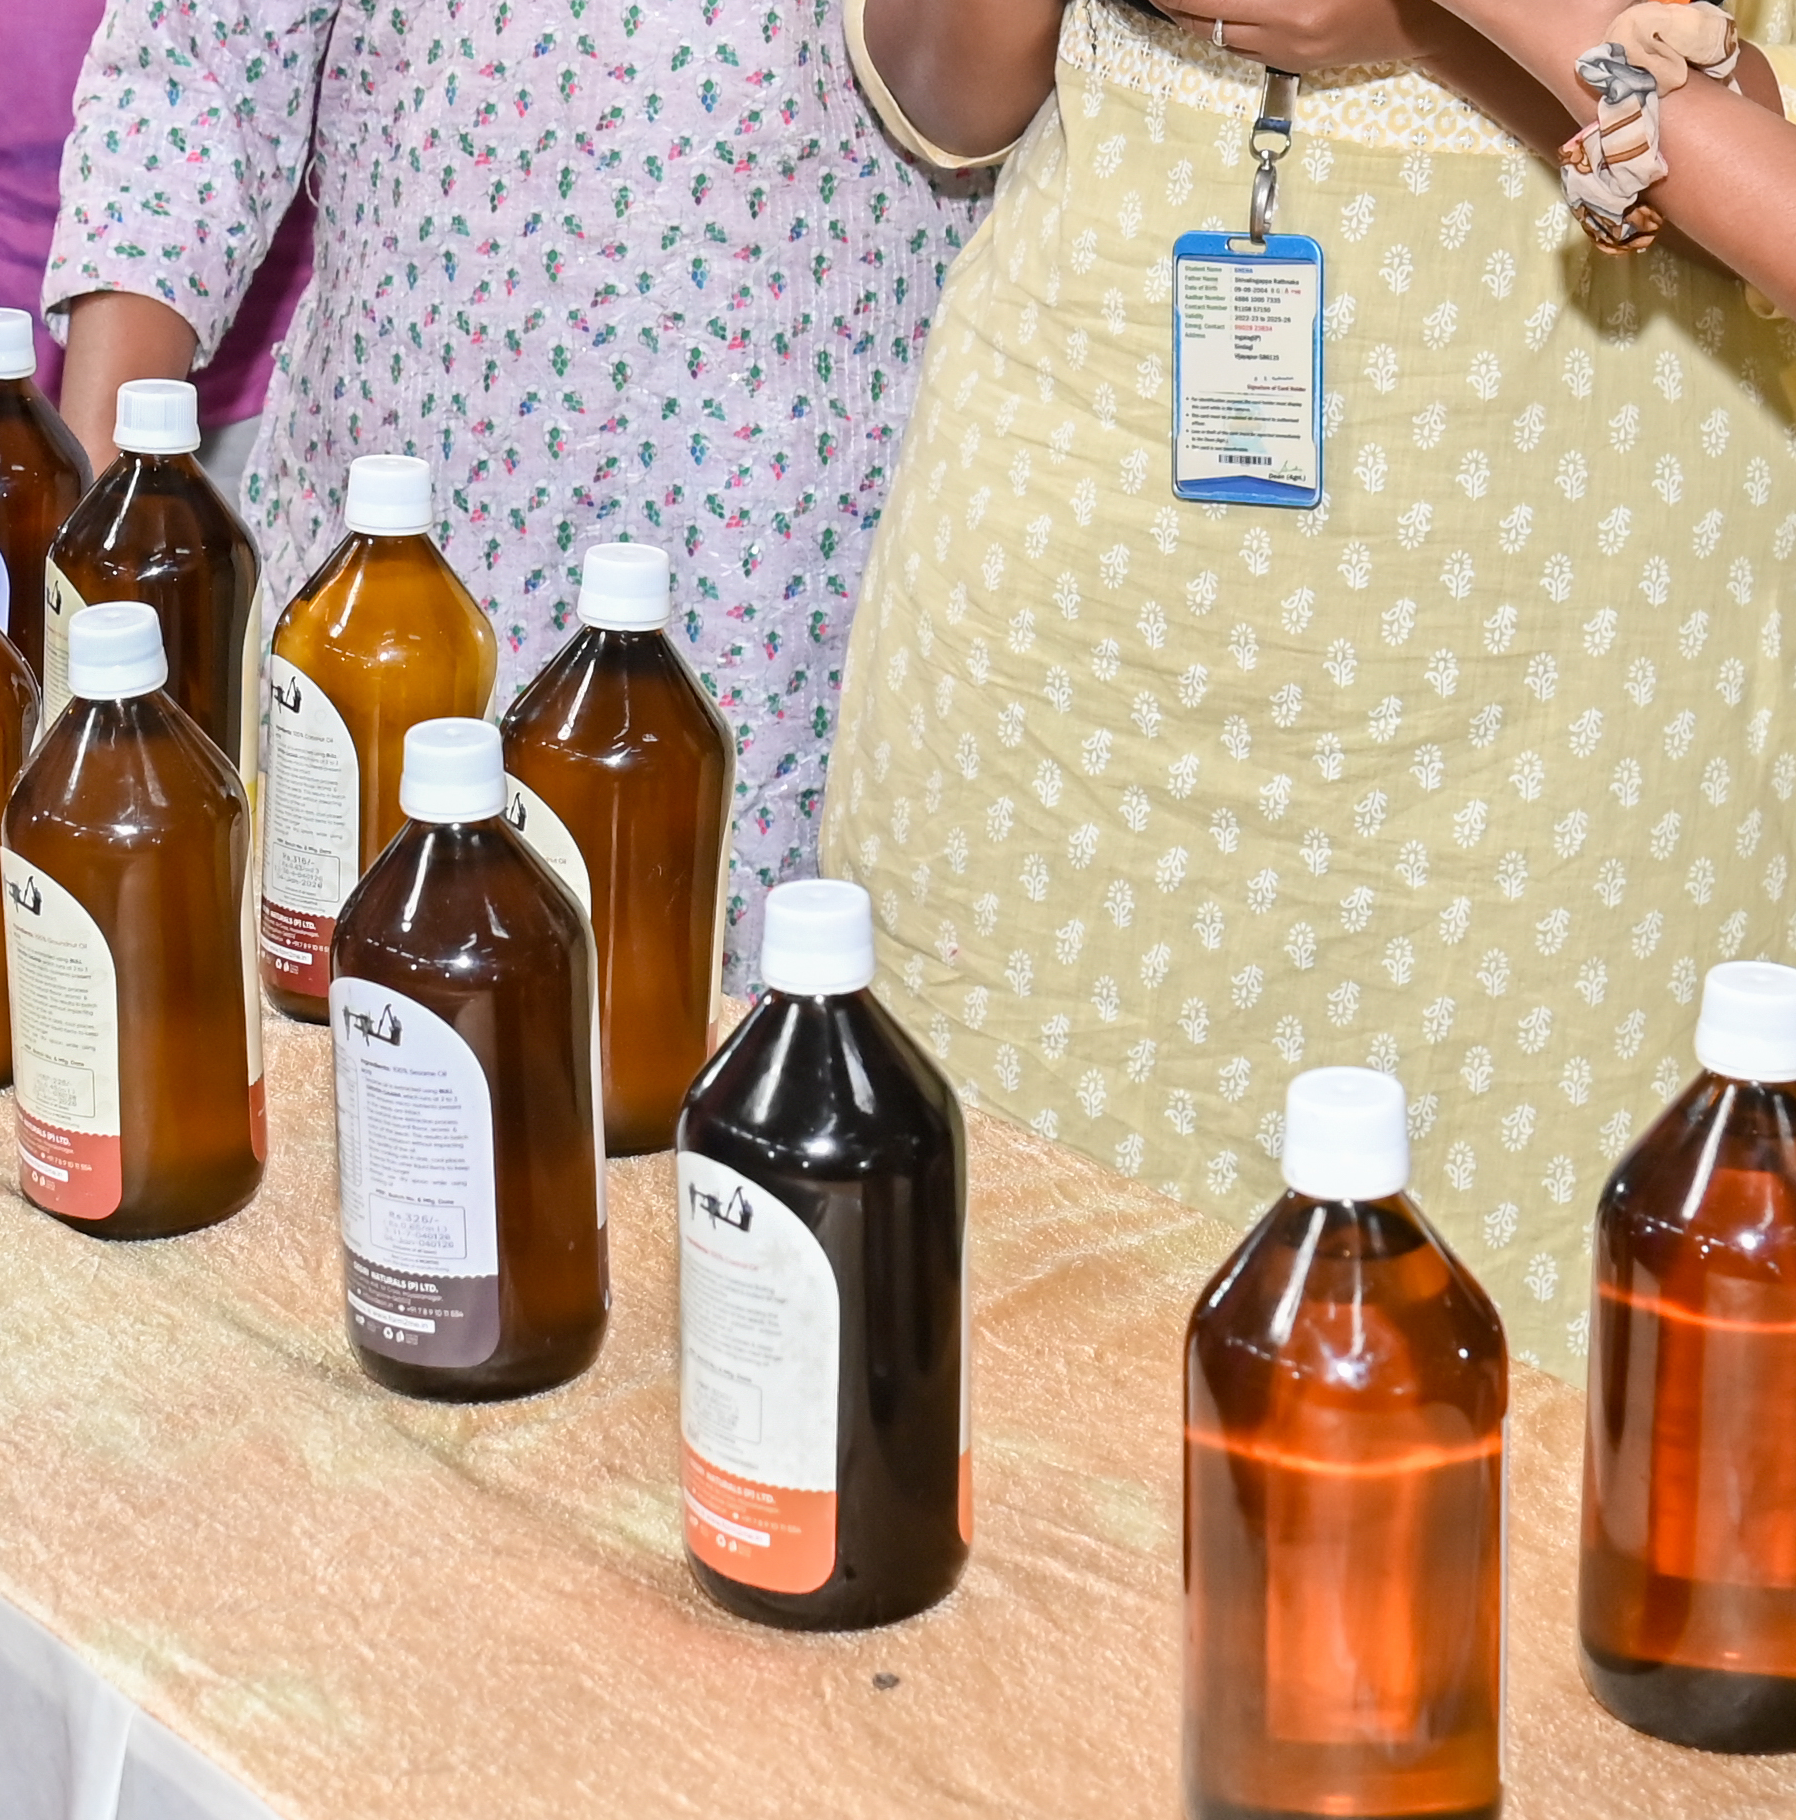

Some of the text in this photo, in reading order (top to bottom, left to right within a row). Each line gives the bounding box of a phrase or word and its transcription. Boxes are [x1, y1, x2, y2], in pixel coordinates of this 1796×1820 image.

[371, 1270, 406, 1289] NATURALS
[408, 1281, 418, 1292] (P)
[420, 1283, 438, 1293] LTD.
[756, 1491, 776, 1504] LTD.
